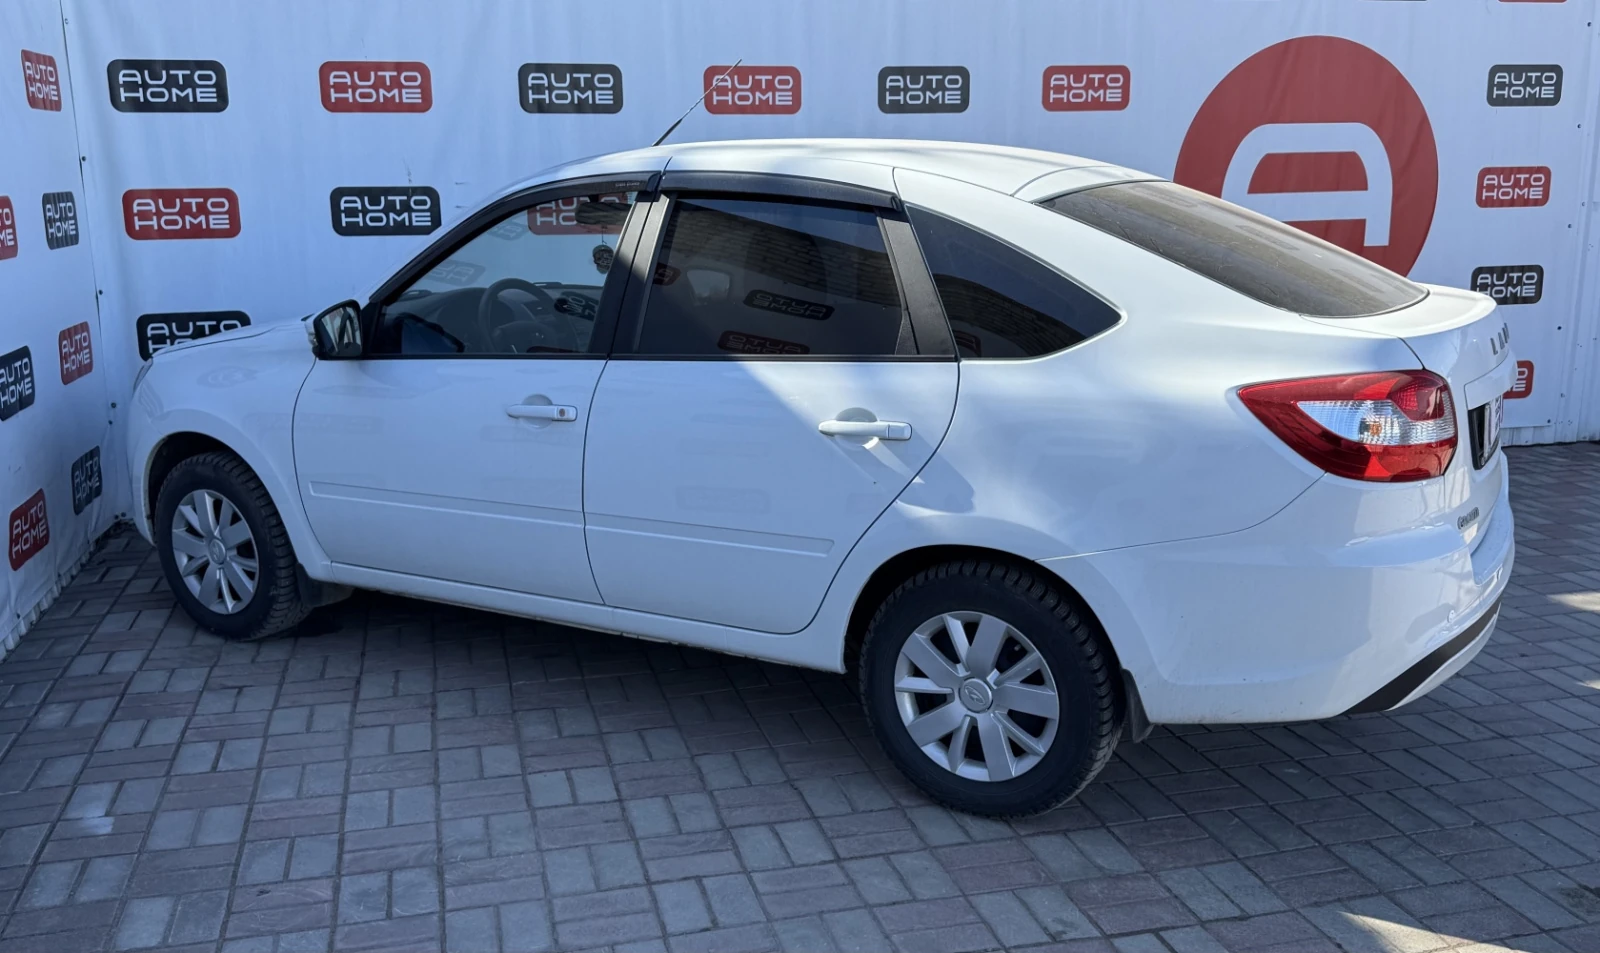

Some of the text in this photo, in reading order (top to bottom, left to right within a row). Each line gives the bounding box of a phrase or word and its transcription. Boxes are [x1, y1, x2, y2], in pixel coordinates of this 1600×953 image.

[24, 61, 56, 82] AUTO
[118, 69, 217, 85] AUTO
[329, 71, 422, 86] AUTO
[1494, 72, 1556, 85] AUTO
[528, 73, 614, 88] AUTO
[712, 75, 793, 89] AUTO
[885, 74, 963, 89] AUTO
[1050, 73, 1124, 88] AUTO
[29, 82, 59, 101] HOME
[120, 87, 218, 103] HOME
[330, 88, 422, 103] HOME
[528, 90, 614, 105] HOME
[713, 91, 793, 106] HOME
[885, 90, 962, 105] HOME
[1049, 88, 1122, 103] HOME
[1492, 85, 1555, 99] HOME
[1483, 174, 1545, 188] AUTO
[1482, 187, 1543, 201] HOME
[46, 202, 74, 219] AUTO
[133, 198, 230, 214] AUTO
[340, 195, 430, 210] AUTO
[134, 214, 231, 231] HOME
[341, 211, 432, 227] HOME
[48, 220, 77, 239] HOME
[1477, 271, 1538, 286] AUTO
[62, 331, 89, 357] AUTO
[63, 348, 91, 375] HOME
[0, 357, 31, 387] AUTO
[0, 376, 33, 409] HOME
[74, 456, 99, 488] AUTO
[75, 472, 100, 505] HOME
[12, 500, 45, 540] AUTO
[12, 518, 47, 560] HOME
